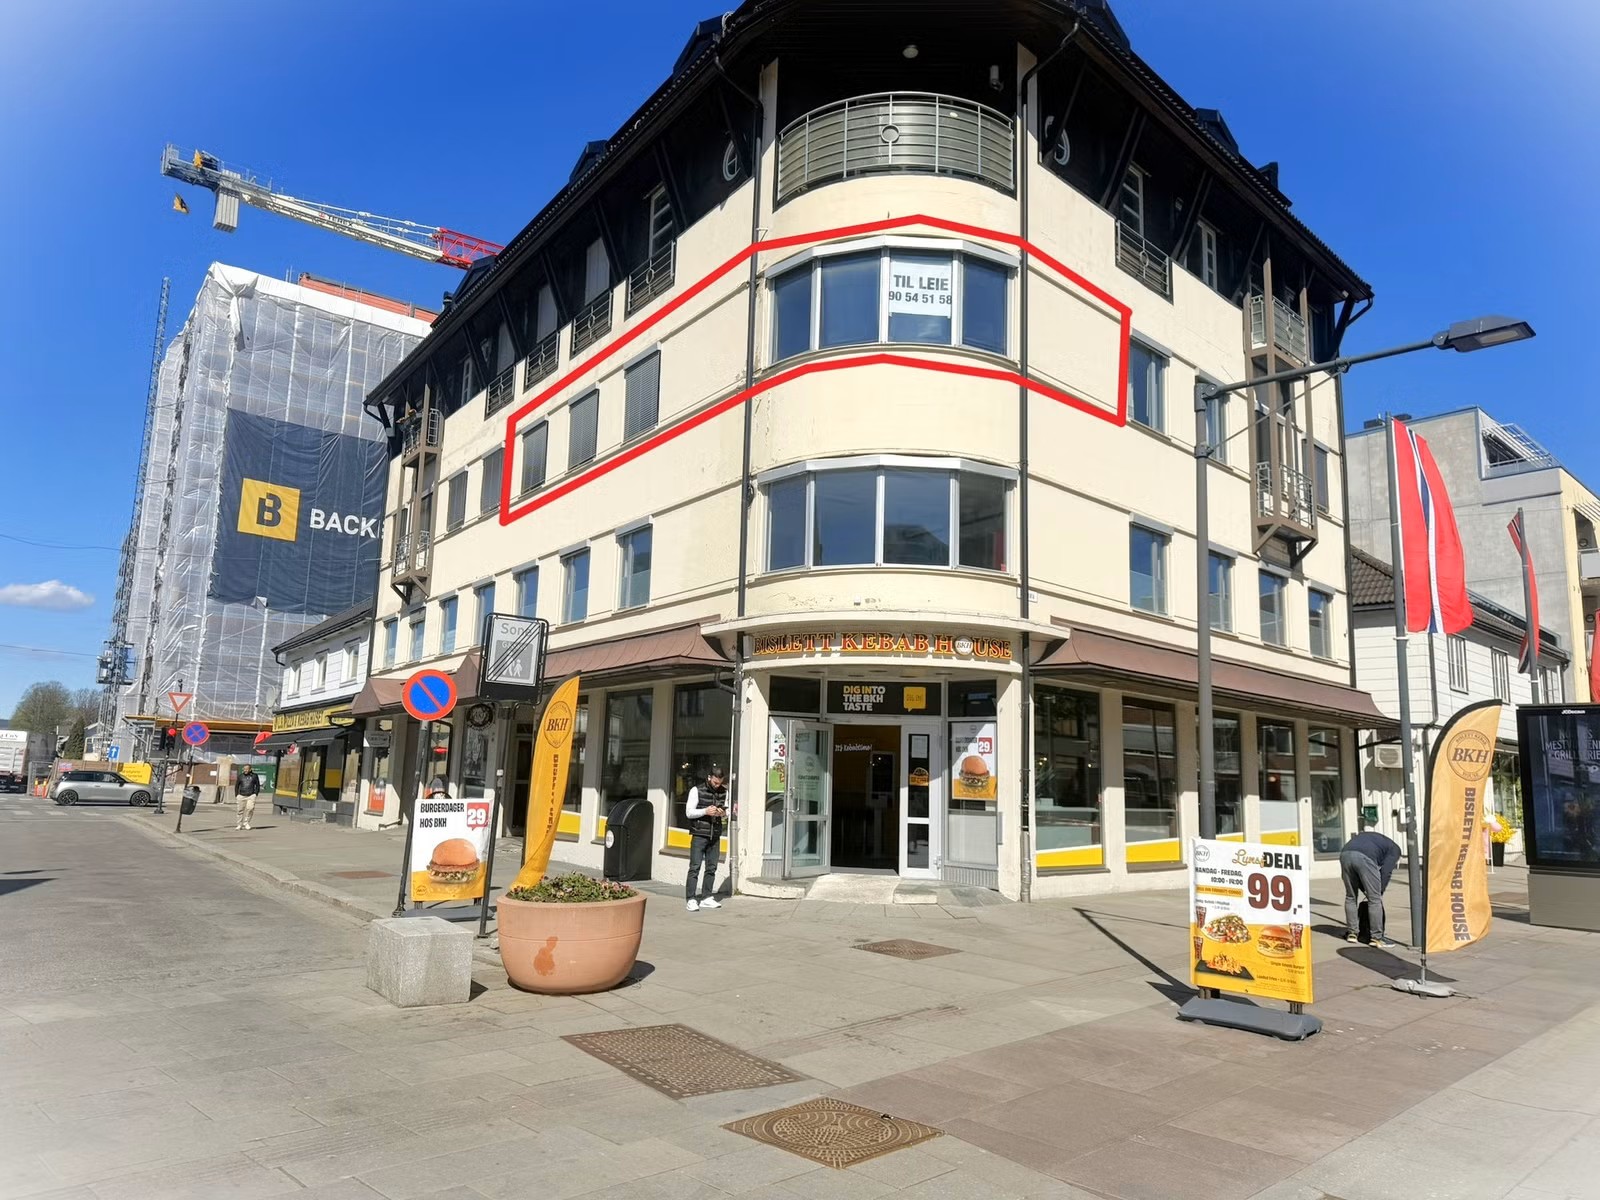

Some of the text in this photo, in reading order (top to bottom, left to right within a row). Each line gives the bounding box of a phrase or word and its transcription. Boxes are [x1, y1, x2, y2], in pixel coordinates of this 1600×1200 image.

[893, 274, 949, 291] TIL LEIE
[889, 290, 952, 304] 90 54 51 58
[309, 507, 384, 539] BACK
[753, 631, 835, 655] BISLETT
[841, 631, 930, 653] KEBAB
[843, 685, 861, 694] DIG
[843, 694, 884, 703] THE BKH
[843, 702, 873, 711] TASTE
[546, 718, 569, 731] BKH
[1452, 747, 1490, 763] BKH
[420, 803, 465, 813] BURGERDAGER
[419, 818, 447, 828] HOS BKH
[1263, 852, 1302, 870] DEAL
[1450, 787, 1476, 941] BISLETT KEBAB HOUSE
